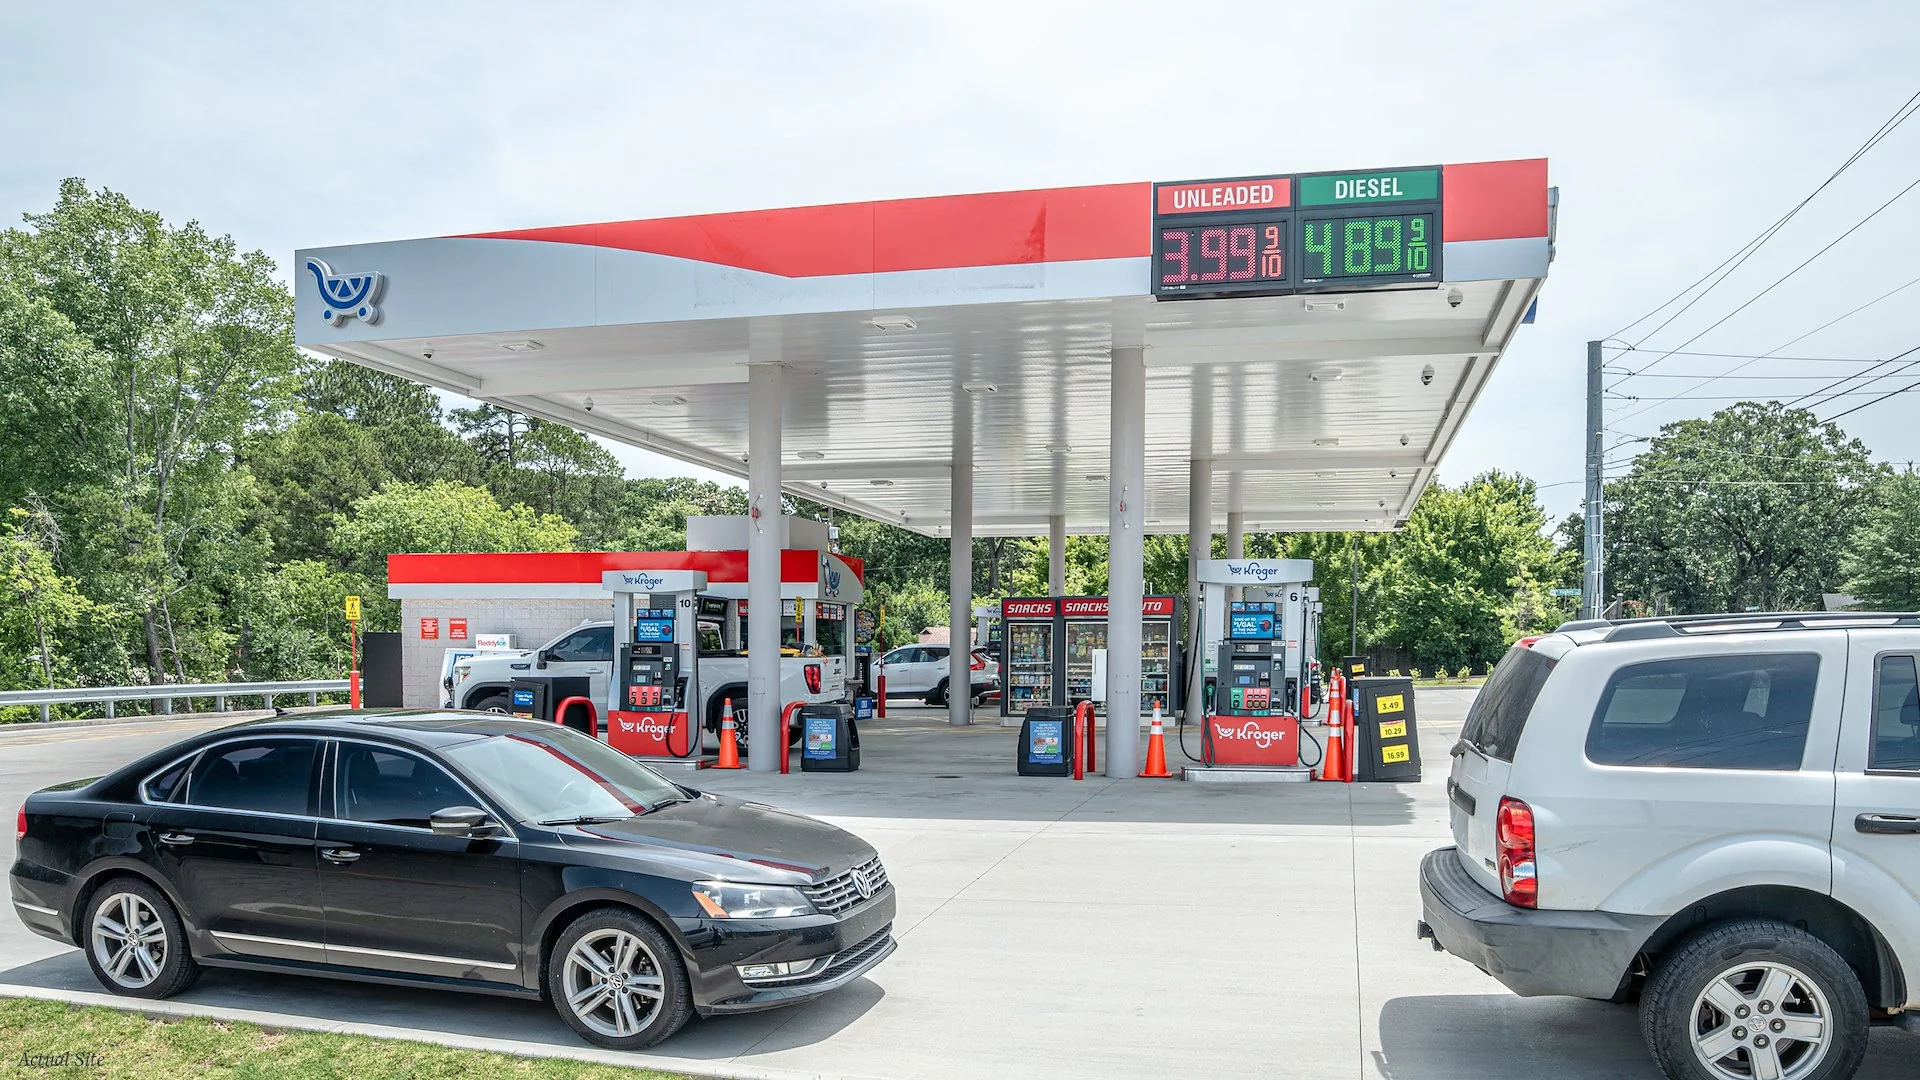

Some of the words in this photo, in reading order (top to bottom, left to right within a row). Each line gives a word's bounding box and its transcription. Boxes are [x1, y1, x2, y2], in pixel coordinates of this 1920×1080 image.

[1335, 177, 1403, 200] DIESEL
[1173, 184, 1274, 209] UNLEADED
[1163, 227, 1256, 284] 3.99
[1244, 562, 1278, 580] Kroger
[634, 572, 664, 590] Kroger
[1290, 592, 1298, 602] 6
[680, 600, 690, 608] 10
[1007, 603, 1052, 614] SNACKS
[1065, 602, 1108, 612] SNACKS
[1142, 602, 1162, 611] TO
[1382, 702, 1399, 710] 3.49
[1237, 722, 1285, 748] Kroger
[1384, 727, 1402, 736] 10.29
